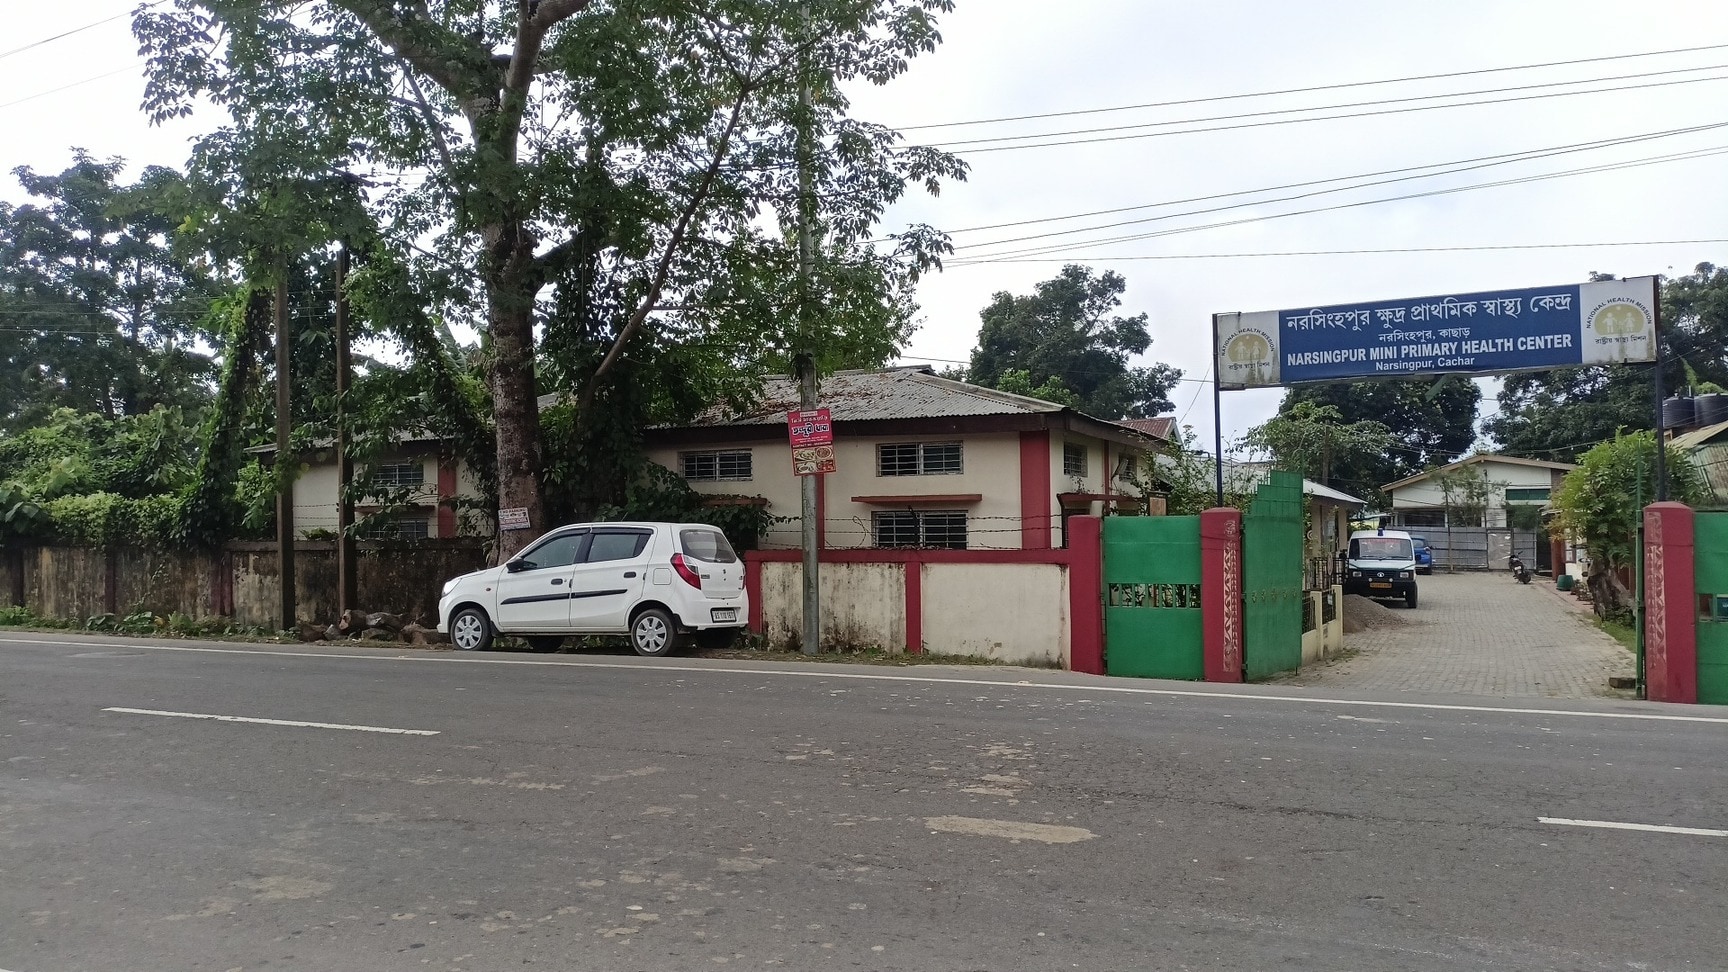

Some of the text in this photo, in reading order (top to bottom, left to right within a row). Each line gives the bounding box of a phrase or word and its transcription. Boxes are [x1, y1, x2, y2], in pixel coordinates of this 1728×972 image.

[1286, 294, 1572, 331] নরসিংহপুর ক্ষুদ্র প্রাথমিক স্বাস্থ্য কেন্দ্র
[1586, 302, 1606, 329] NATIONAL
[1635, 301, 1652, 324] MISSION
[1222, 332, 1238, 356] NATIONAL
[1261, 331, 1275, 352] MISSION
[1287, 334, 1572, 366] NARSINGPUR MINI PRIMARY HEALTH CENTER
[1375, 357, 1475, 371] Narsingpur, Cachar
